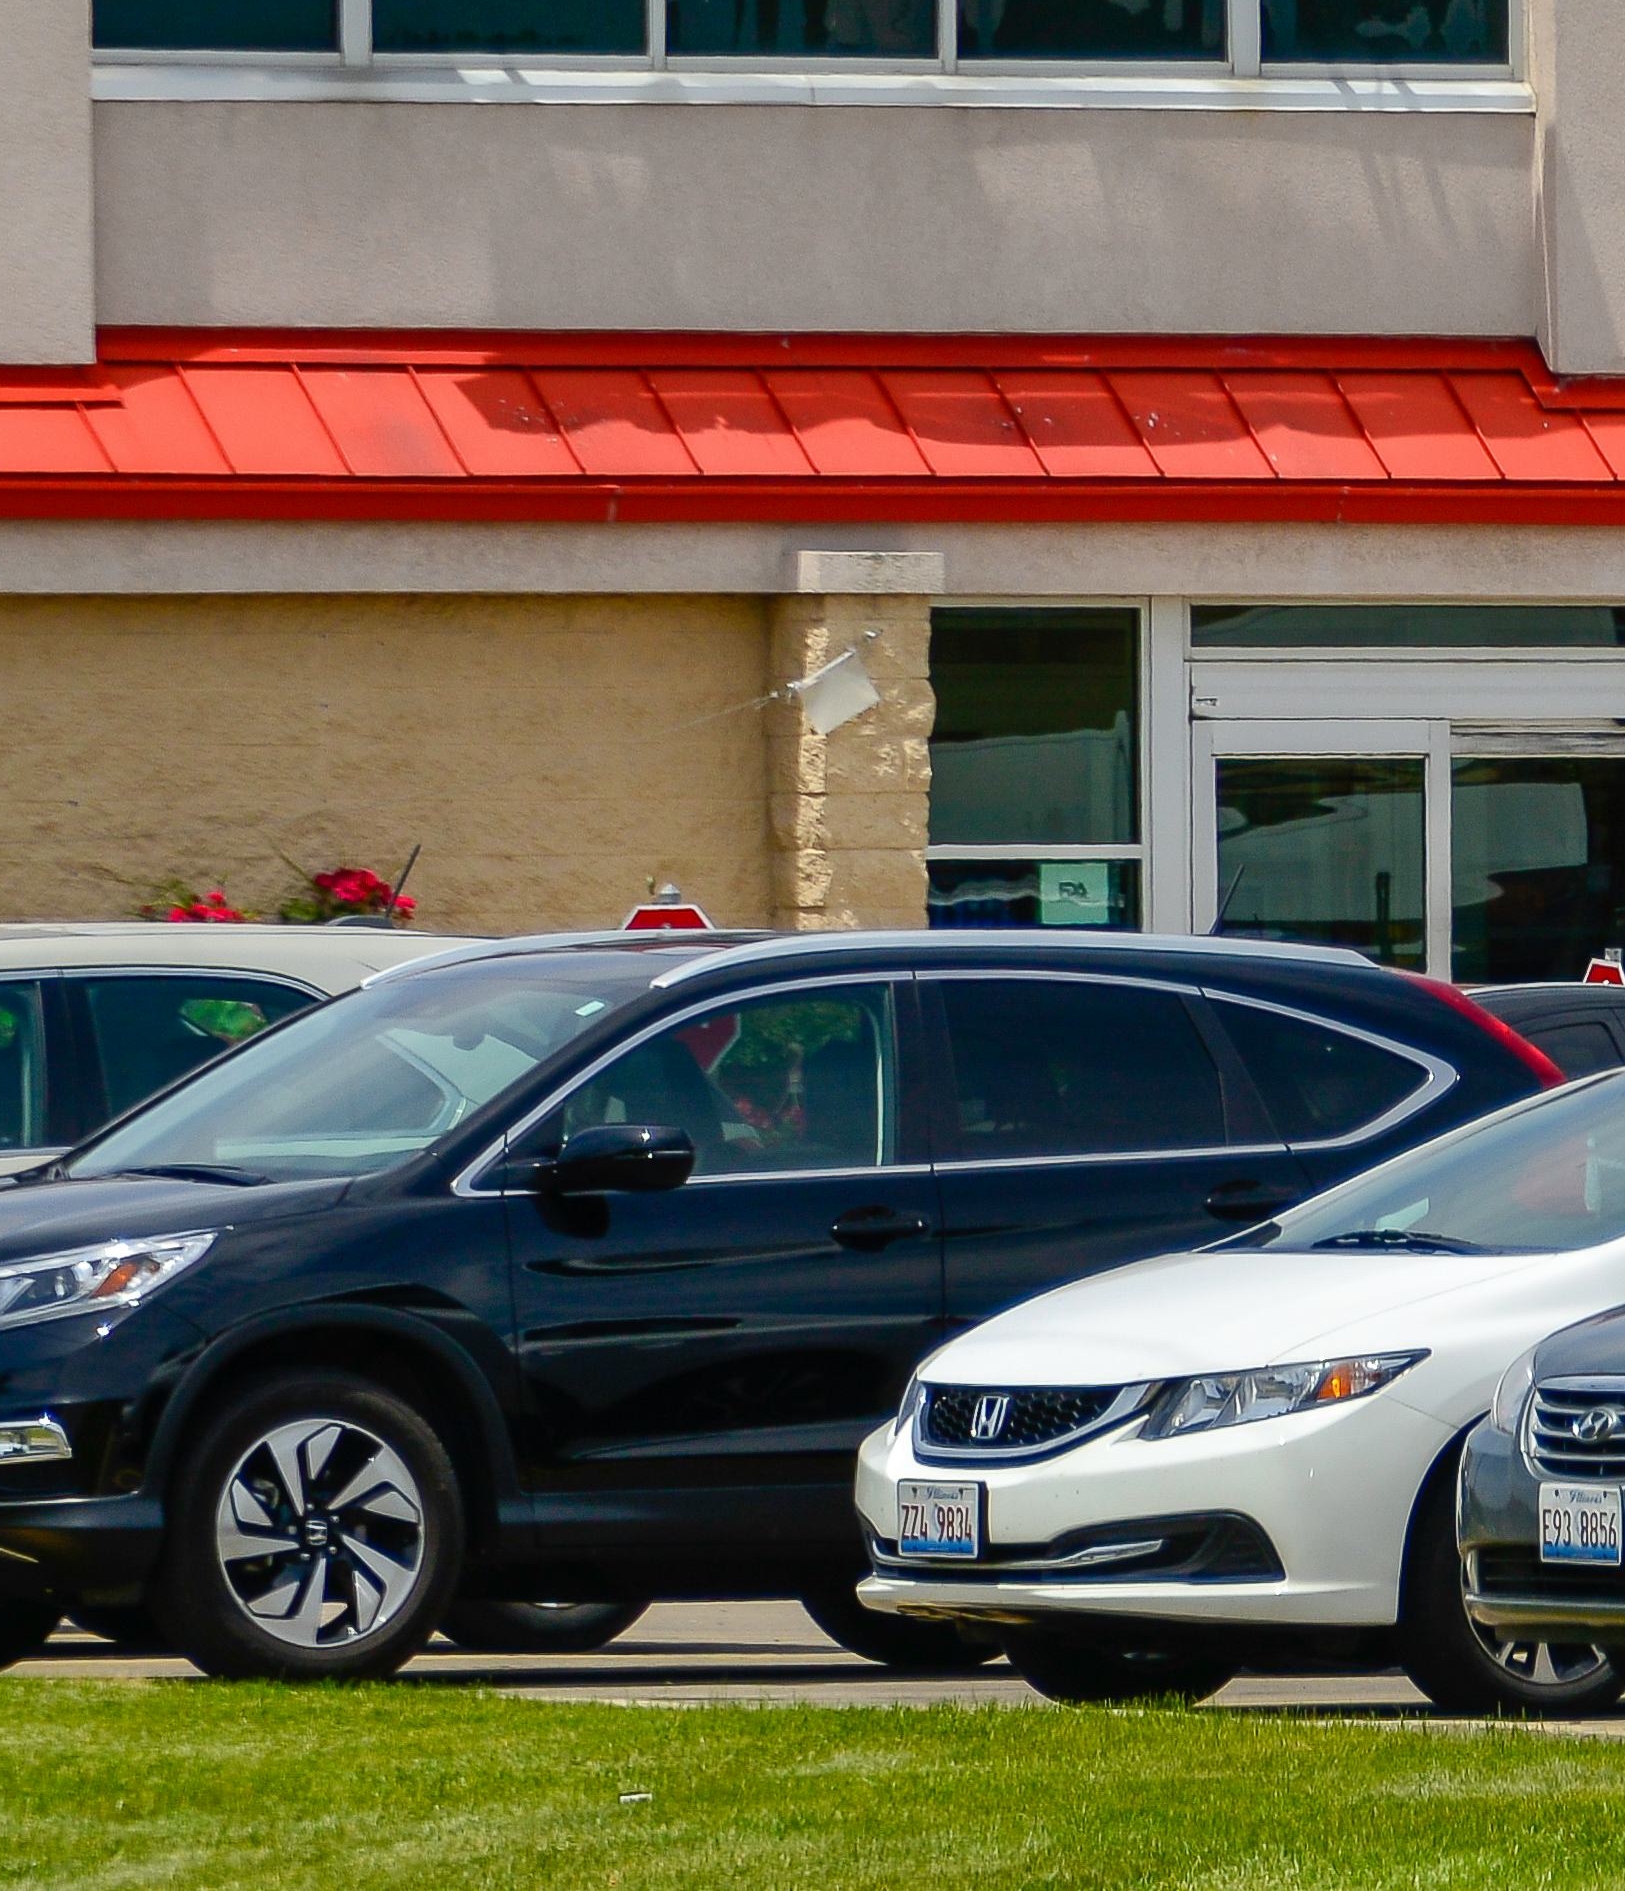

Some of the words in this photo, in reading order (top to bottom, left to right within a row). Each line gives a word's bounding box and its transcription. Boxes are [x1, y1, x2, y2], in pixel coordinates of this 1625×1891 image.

[936, 1506, 972, 1543] 9834
[1543, 1509, 1571, 1547] E93
[1581, 1510, 1617, 1548] 8856
